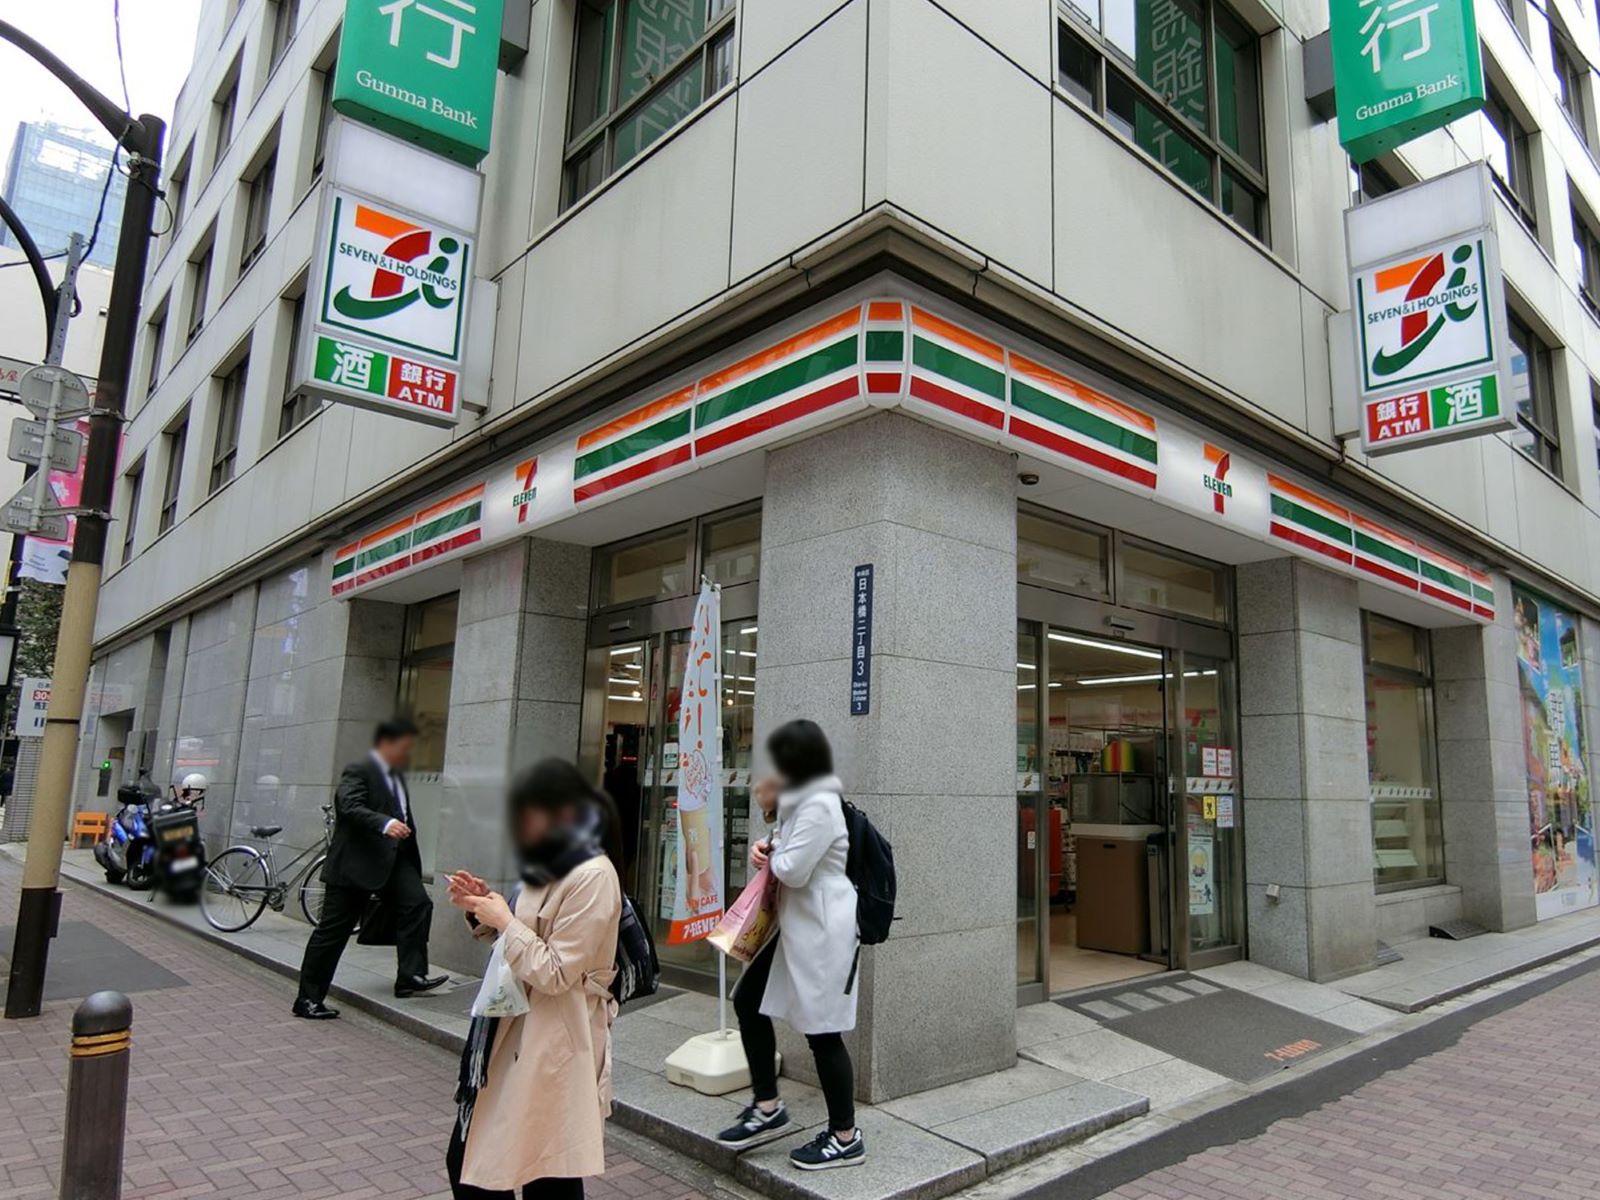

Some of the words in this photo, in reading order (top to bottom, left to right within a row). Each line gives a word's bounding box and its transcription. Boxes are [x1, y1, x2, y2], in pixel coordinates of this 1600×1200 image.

[1359, 0, 1439, 74] 行
[356, 70, 427, 110] Gunma
[431, 97, 478, 129] Bank
[1356, 92, 1413, 120] Gunma
[1416, 74, 1460, 99] Bank
[396, 263, 457, 291] HOLDINGS
[1418, 283, 1479, 310] HOLDINGS
[330, 342, 374, 390] 酒
[400, 362, 446, 392] 銀行
[398, 386, 444, 409] ATM
[1376, 395, 1419, 423] 銀行
[1446, 380, 1482, 425] 酒
[1378, 418, 1421, 439] ATM
